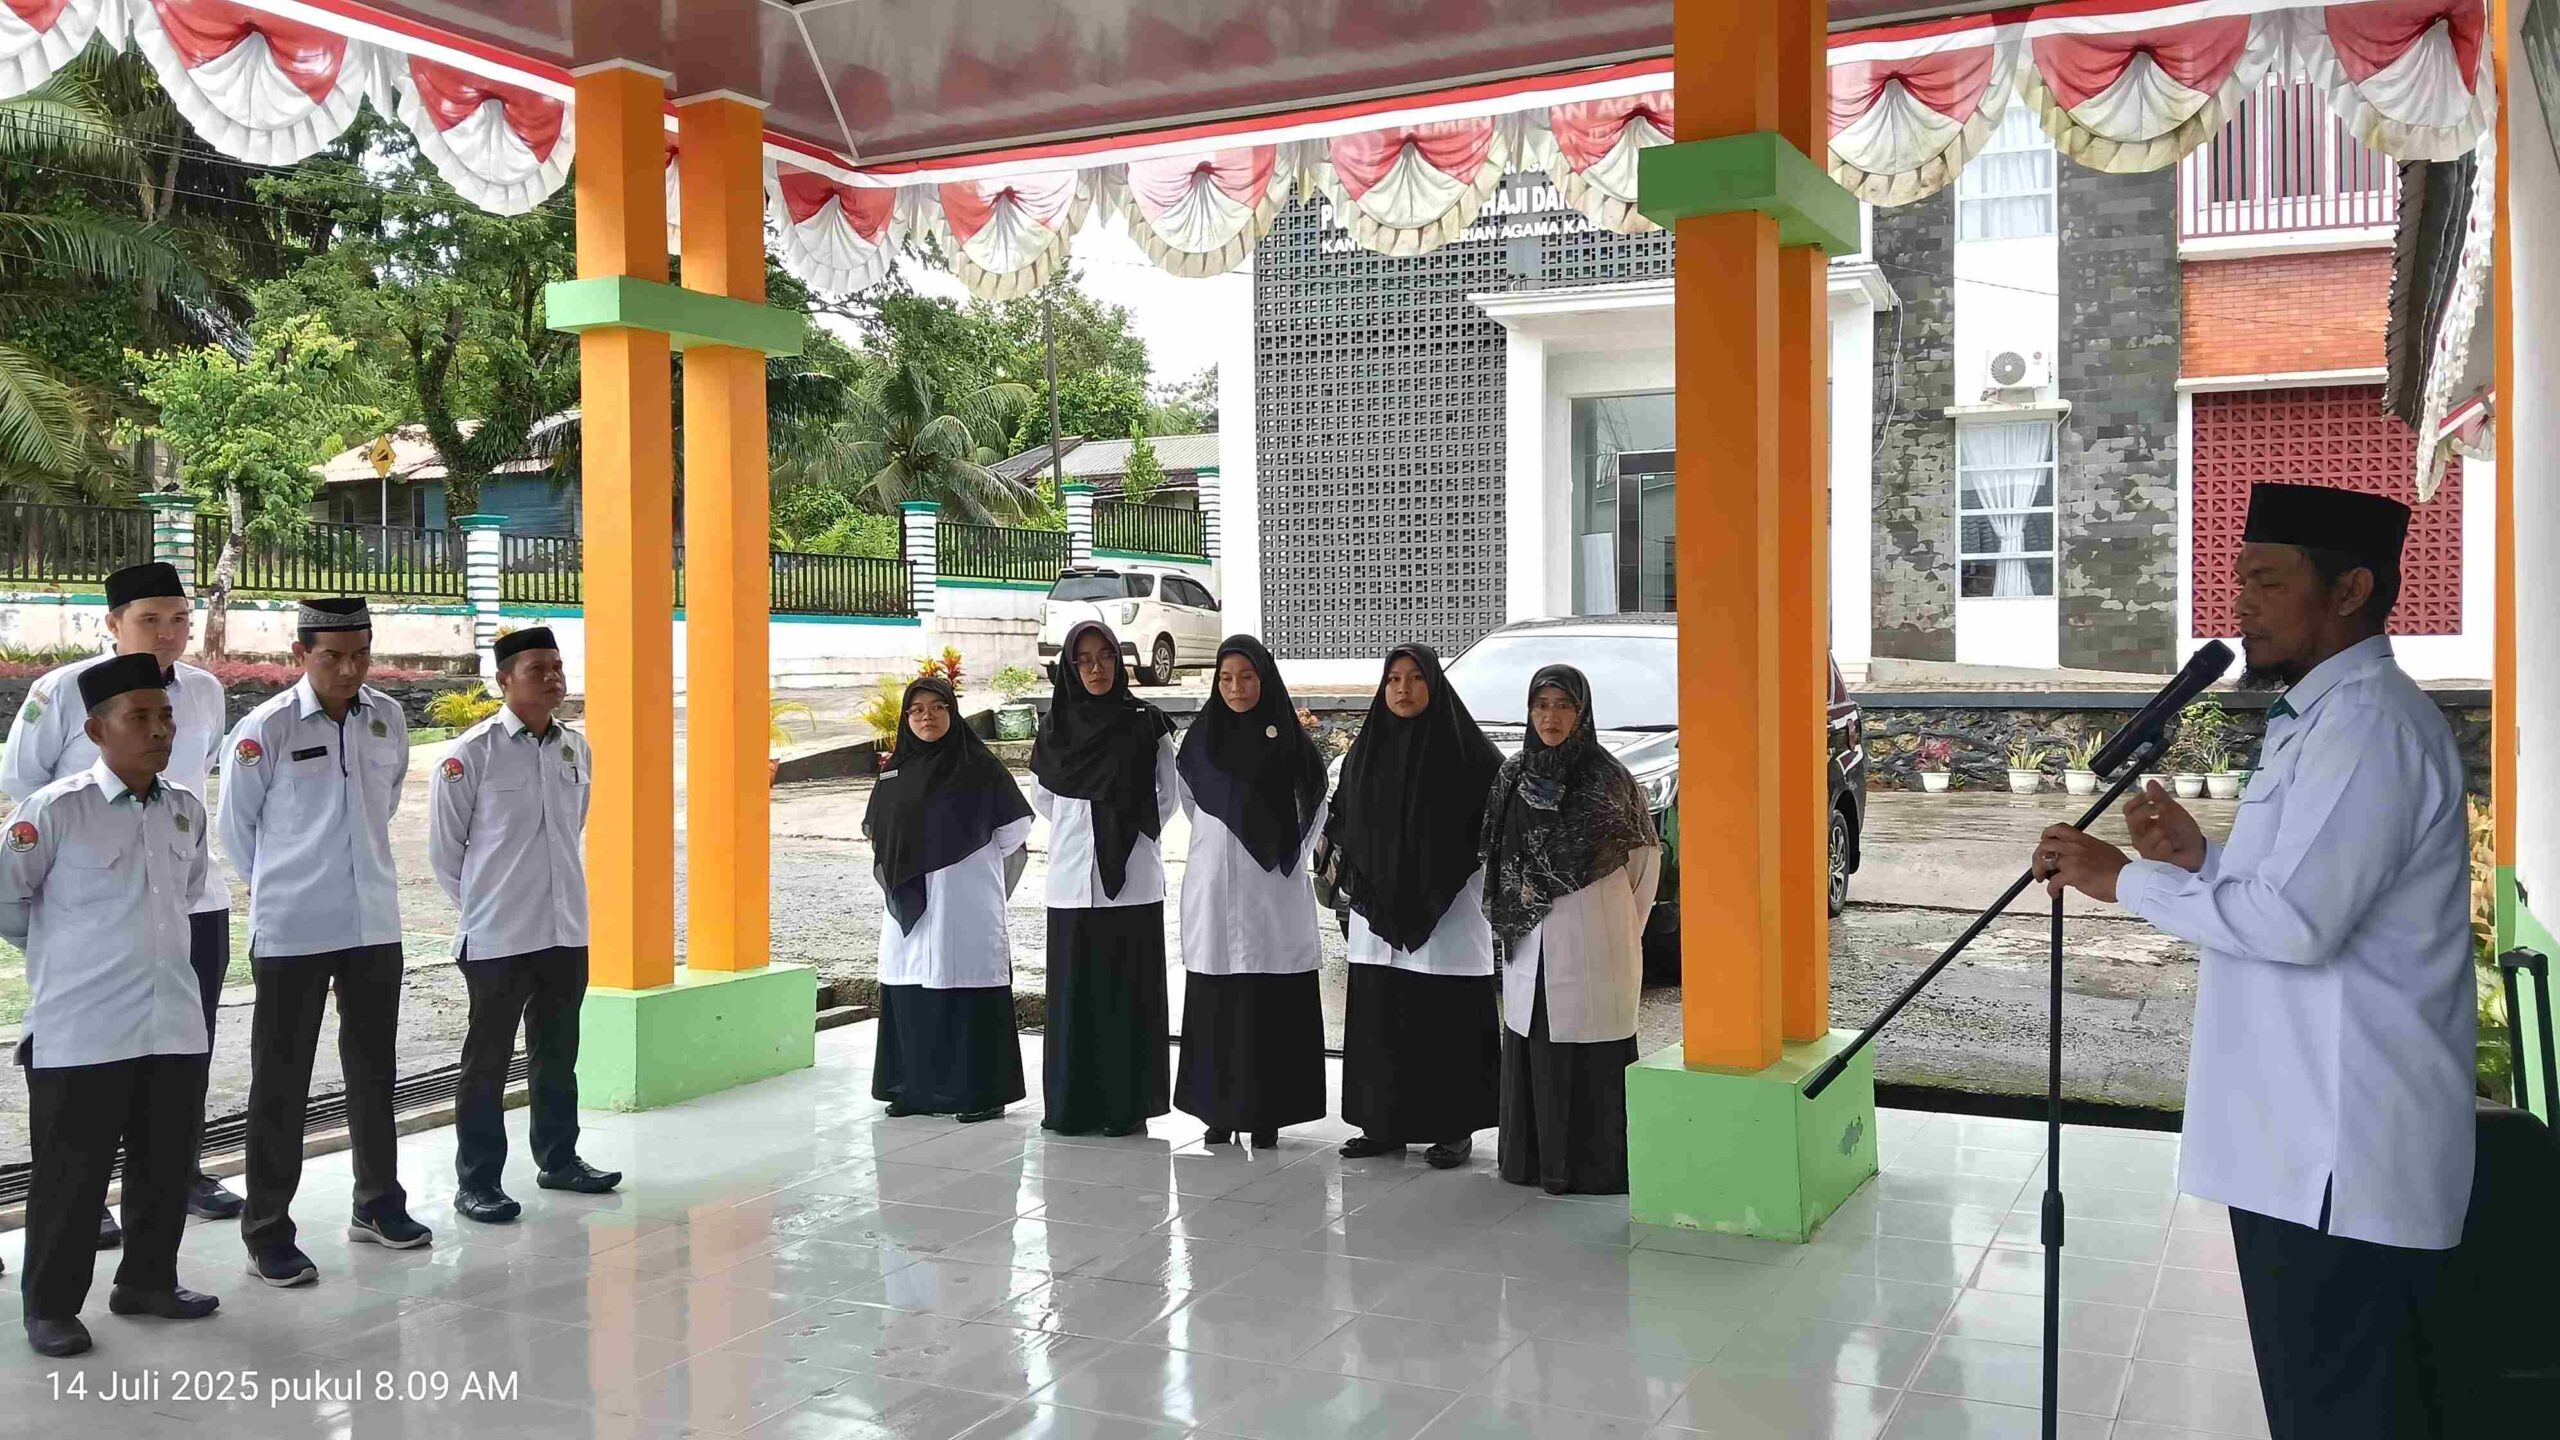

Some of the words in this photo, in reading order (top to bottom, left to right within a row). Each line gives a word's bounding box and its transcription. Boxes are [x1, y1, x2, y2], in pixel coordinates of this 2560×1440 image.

[1482, 186, 1528, 217] HAJI
[1321, 238, 1362, 254] KAN
[1500, 221, 1560, 239] AGAMA
